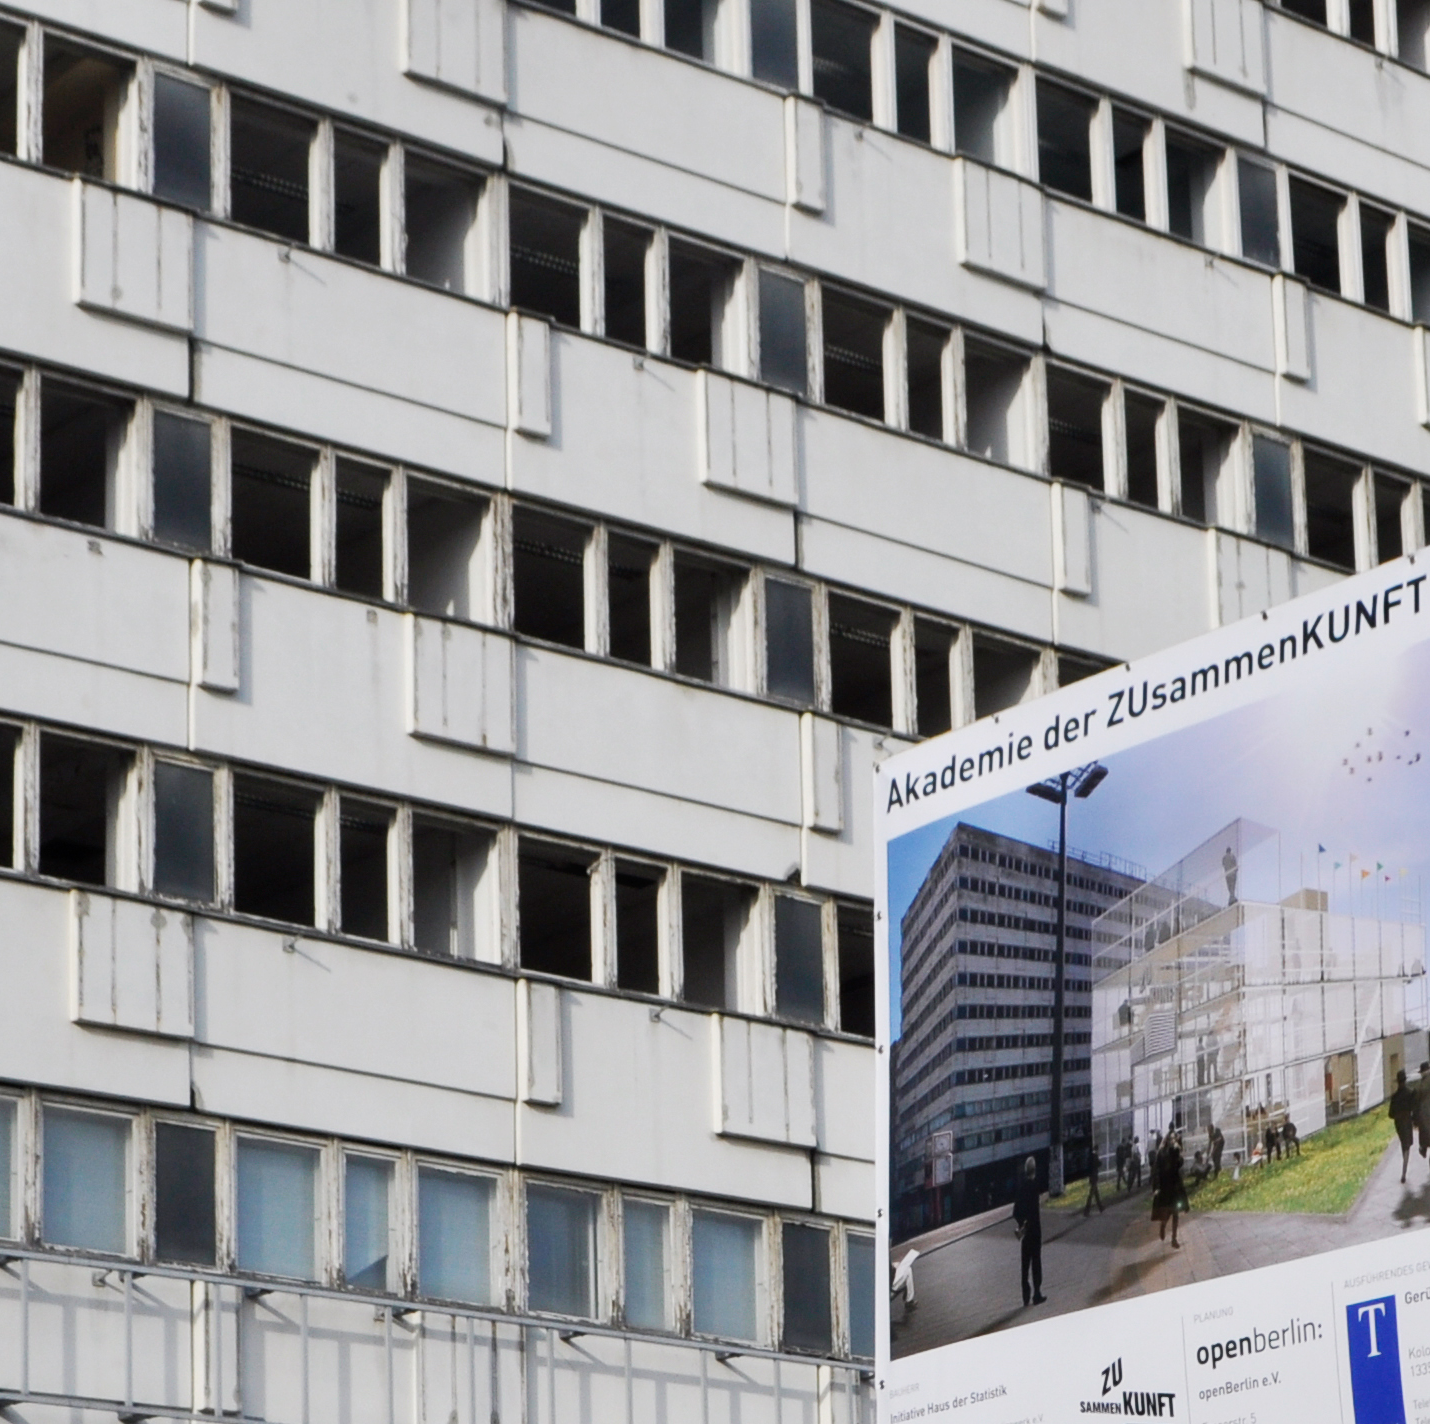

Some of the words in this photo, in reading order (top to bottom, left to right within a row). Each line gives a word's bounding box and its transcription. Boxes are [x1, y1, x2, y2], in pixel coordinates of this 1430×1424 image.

[887, 733, 1032, 814] Akademie
[1043, 709, 1097, 751] der
[1106, 574, 1427, 728] ZUsammenKUNFT
[1193, 1306, 1234, 1325] PLANUNG
[1356, 1301, 1387, 1358] T
[1101, 1356, 1123, 1398] ZU
[1198, 1375, 1260, 1402] openBerlin
[1261, 1371, 1282, 1388] e.V.
[890, 1406, 926, 1424] Initiative
[927, 1399, 951, 1416] Haus
[952, 1395, 968, 1410] der
[970, 1384, 1009, 1405] Statistik
[1079, 1400, 1122, 1416] SAMMEN
[1122, 1391, 1176, 1418] KUNFT
[1249, 1412, 1257, 1424] 5
